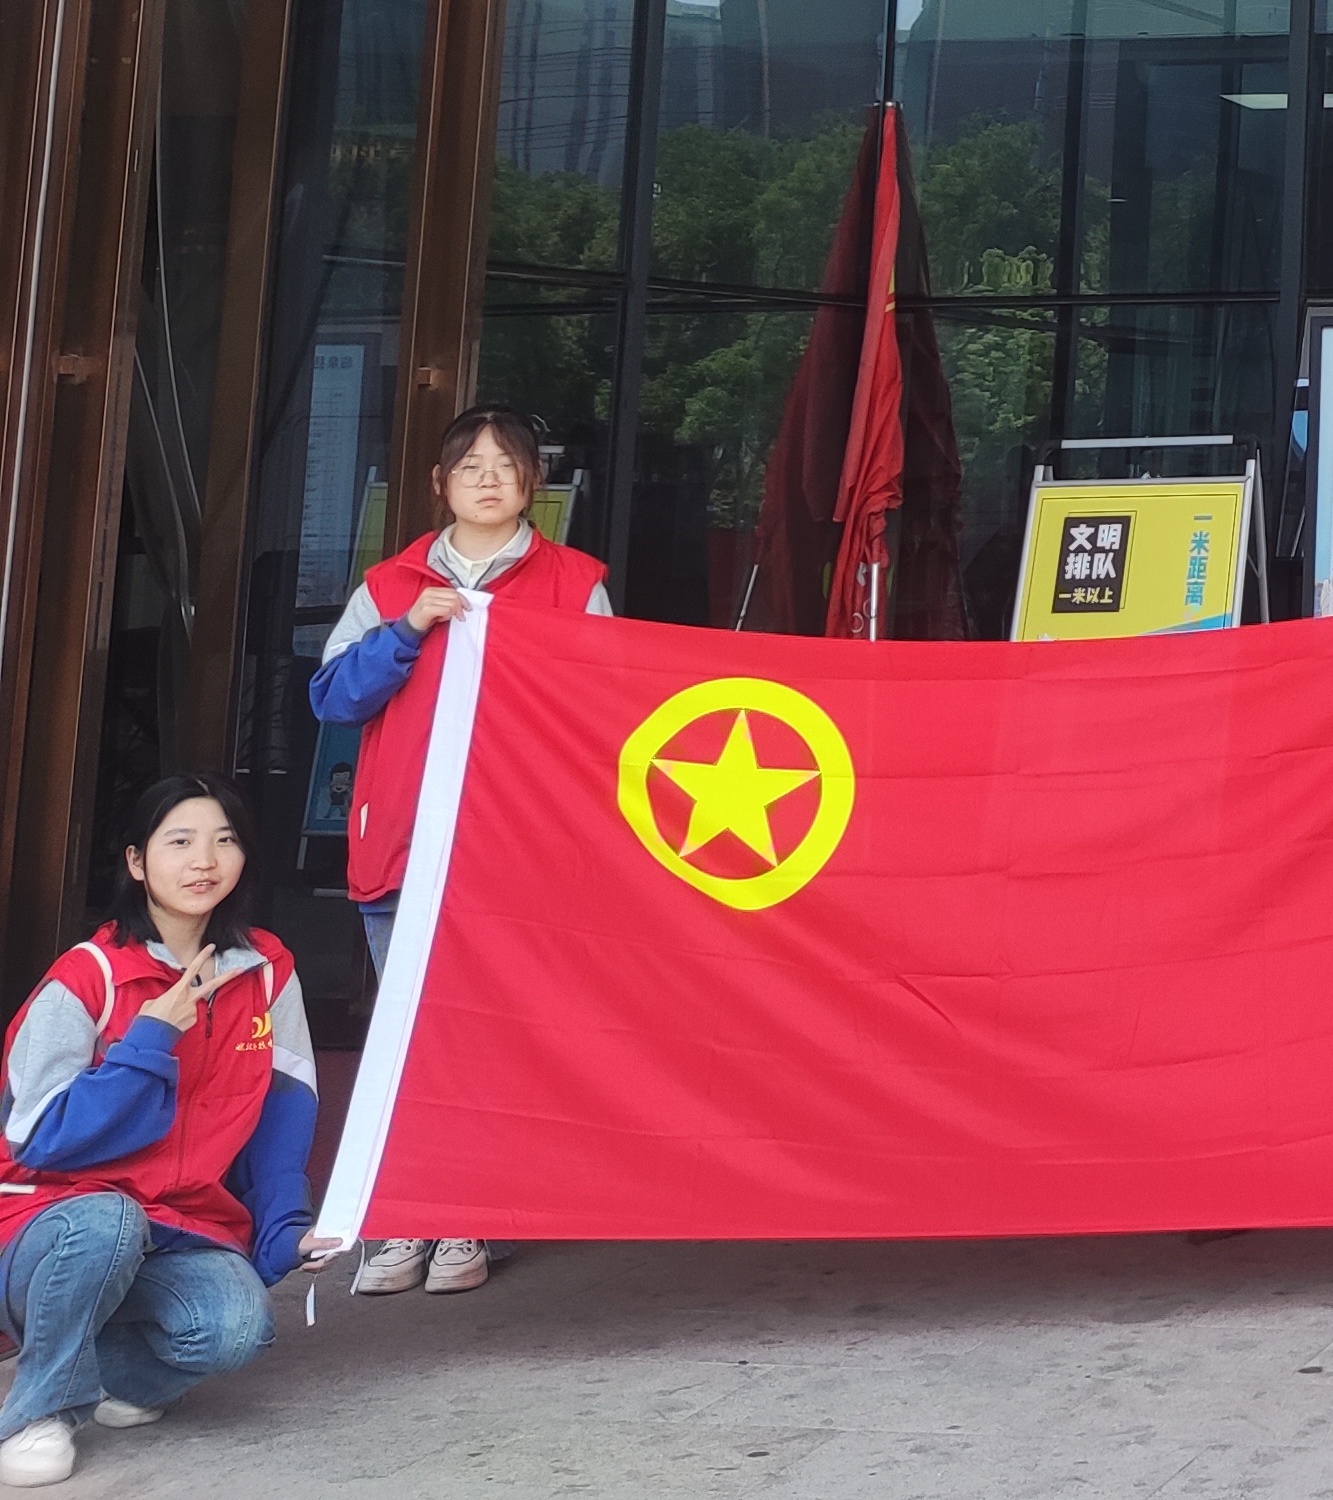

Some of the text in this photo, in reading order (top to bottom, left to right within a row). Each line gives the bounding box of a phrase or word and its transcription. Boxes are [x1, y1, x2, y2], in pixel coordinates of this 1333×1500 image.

[1068, 522, 1123, 551] 文明
[1064, 552, 1117, 580] 排队
[1184, 514, 1213, 607] 一米距离
[1058, 587, 1115, 605] 一米以上
